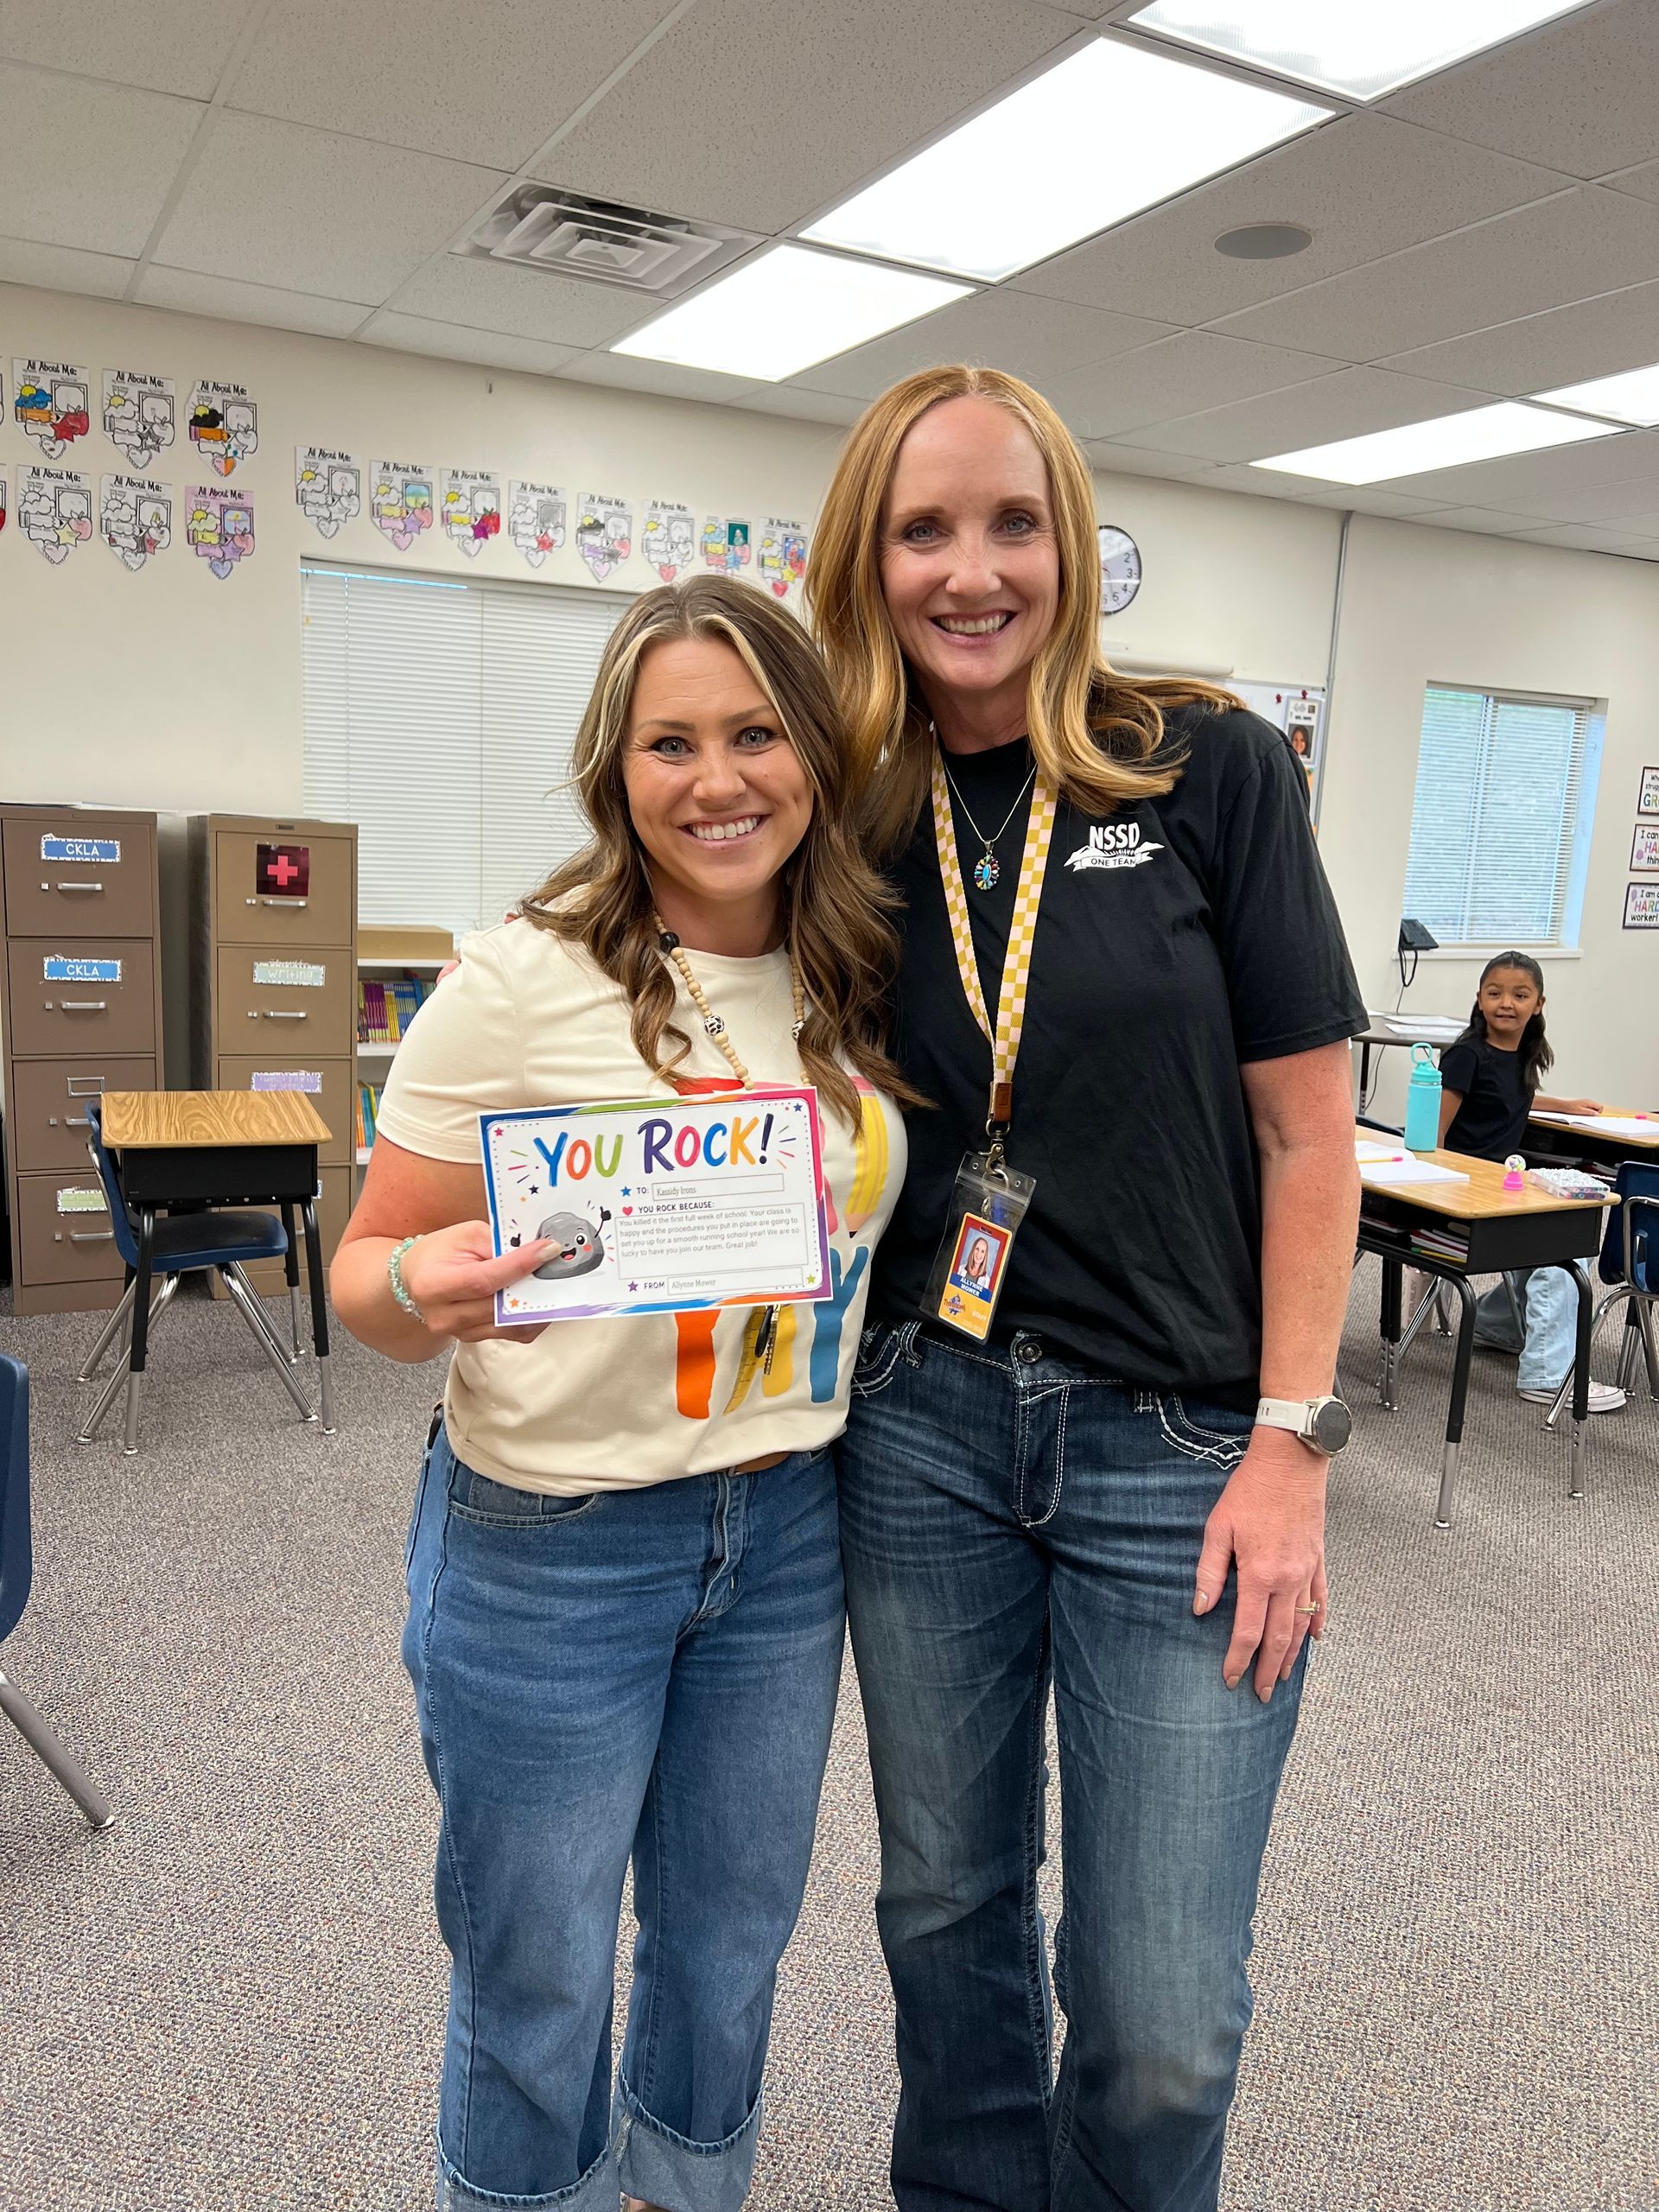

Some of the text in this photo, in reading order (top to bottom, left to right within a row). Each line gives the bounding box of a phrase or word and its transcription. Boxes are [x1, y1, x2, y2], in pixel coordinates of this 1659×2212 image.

[27, 359, 77, 376] All About Me:
[116, 371, 124, 381] All
[127, 372, 148, 384] About
[149, 375, 164, 387] Me:
[200, 380, 247, 396] All About Me:
[31, 467, 40, 476] All
[43, 468, 64, 480] About
[66, 471, 81, 482] Me:
[114, 475, 123, 485] All
[125, 477, 146, 489] About
[148, 480, 162, 492] Me:
[198, 486, 245, 500] All About Me:
[1123, 553, 1131, 563] 2
[1127, 569, 1133, 579] 3
[1122, 583, 1128, 594] 4
[1090, 822, 1140, 850] NSSD
[1641, 830, 1645, 839] I
[66, 843, 99, 856] CKLA
[1090, 857, 1136, 867] ONE TEAM
[1631, 912, 1659, 922] worker!
[66, 964, 99, 976] CKLA
[533, 1113, 774, 1187] YOU ROCK!
[657, 1186, 679, 1197] Kassidy
[639, 1201, 715, 1214] YOU ROCK BECAUSE:
[668, 1225, 705, 1235] procedures
[700, 1233, 725, 1242] running
[726, 1230, 748, 1239] school
[749, 1229, 766, 1237] year!
[665, 1247, 678, 1255] you
[679, 1245, 691, 1255] join
[745, 1240, 758, 1249] job!
[671, 1281, 694, 1290] Allynne
[960, 1277, 983, 1293] ALLYNNE
[960, 1283, 981, 1298] MOWER
